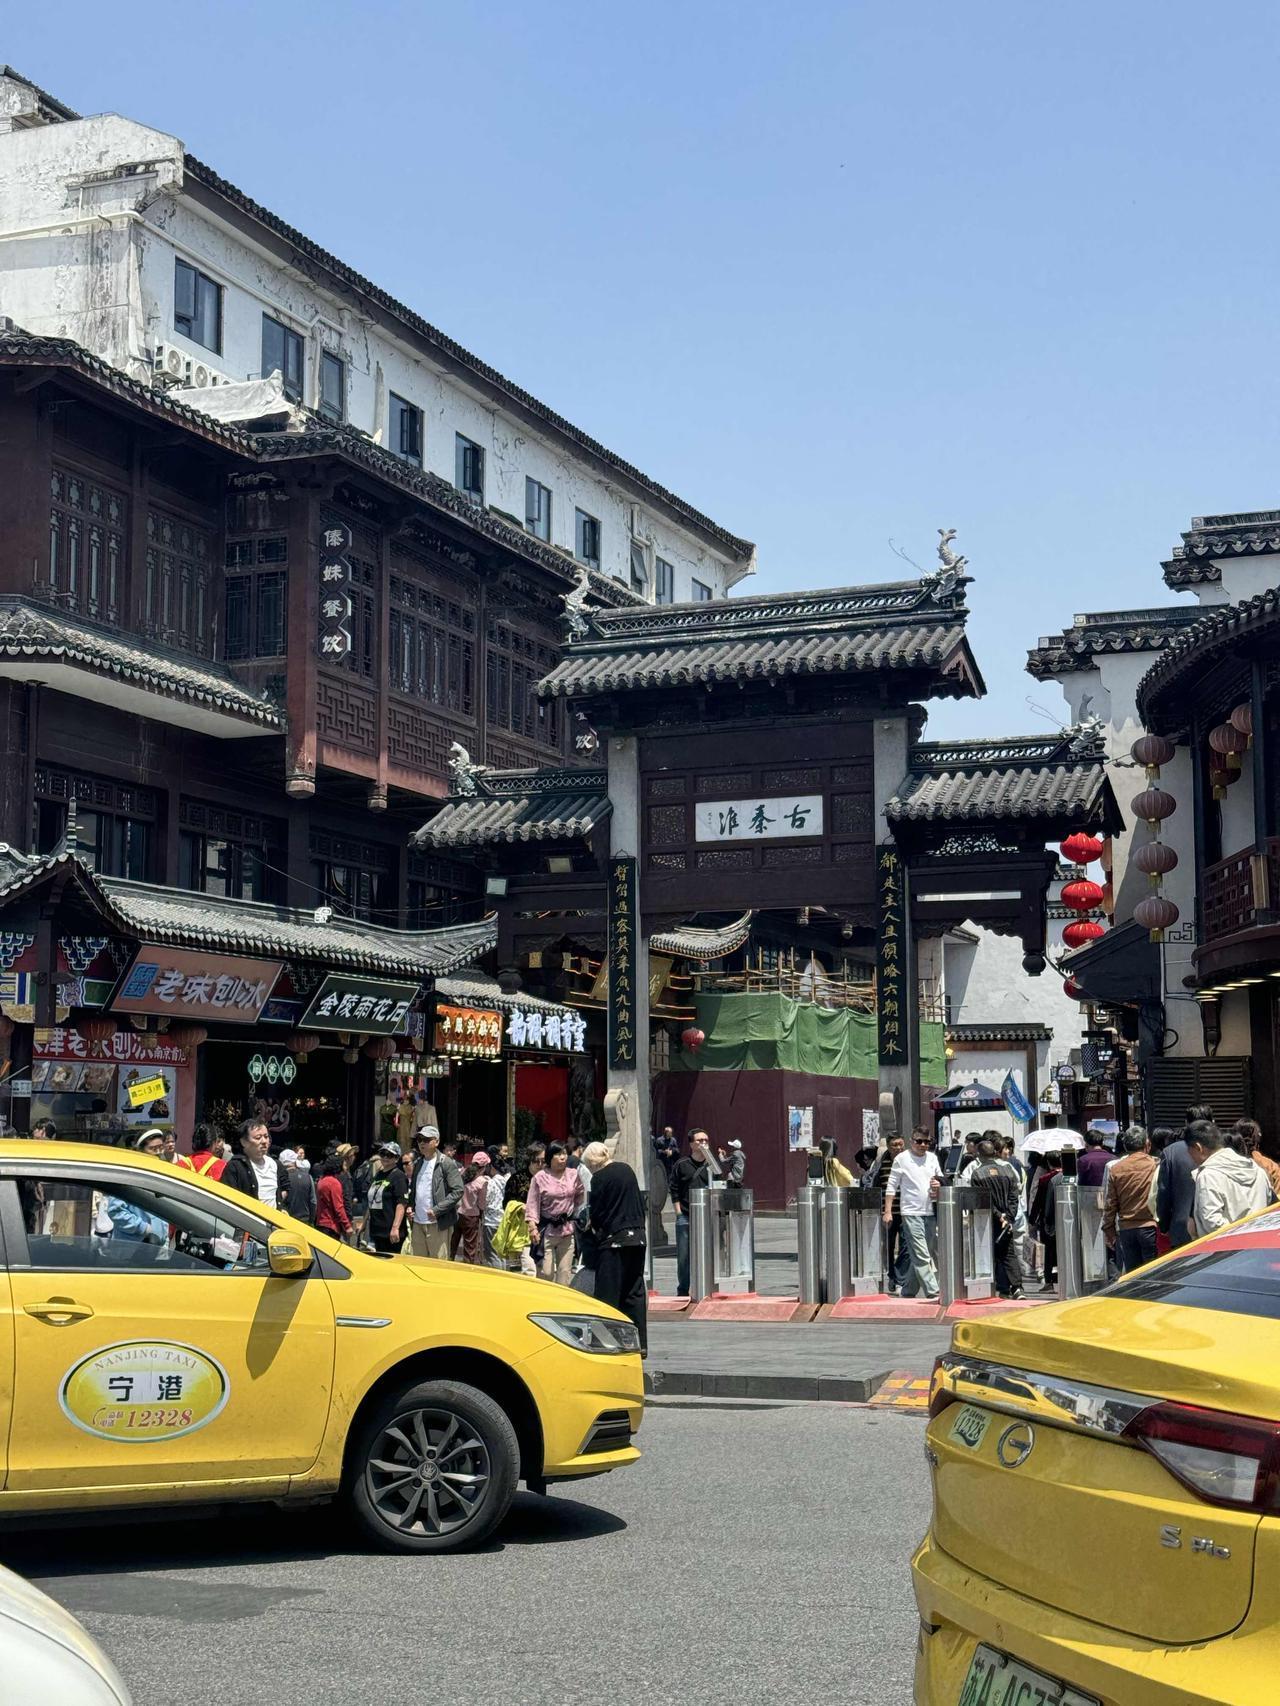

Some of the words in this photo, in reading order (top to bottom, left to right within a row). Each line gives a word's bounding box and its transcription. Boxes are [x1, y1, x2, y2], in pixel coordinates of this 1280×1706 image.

[322, 529, 344, 653] 傣妹餐饮
[719, 804, 811, 835] 古秦淮
[154, 967, 266, 1009] 老味刨冰
[316, 993, 409, 1023] 金陵雨花石
[95, 1349, 158, 1371] NANJING
[165, 1350, 198, 1369] TAXI
[108, 1375, 183, 1402] 宁港
[125, 1408, 194, 1428] 12328
[1160, 1523, 1182, 1549] S
